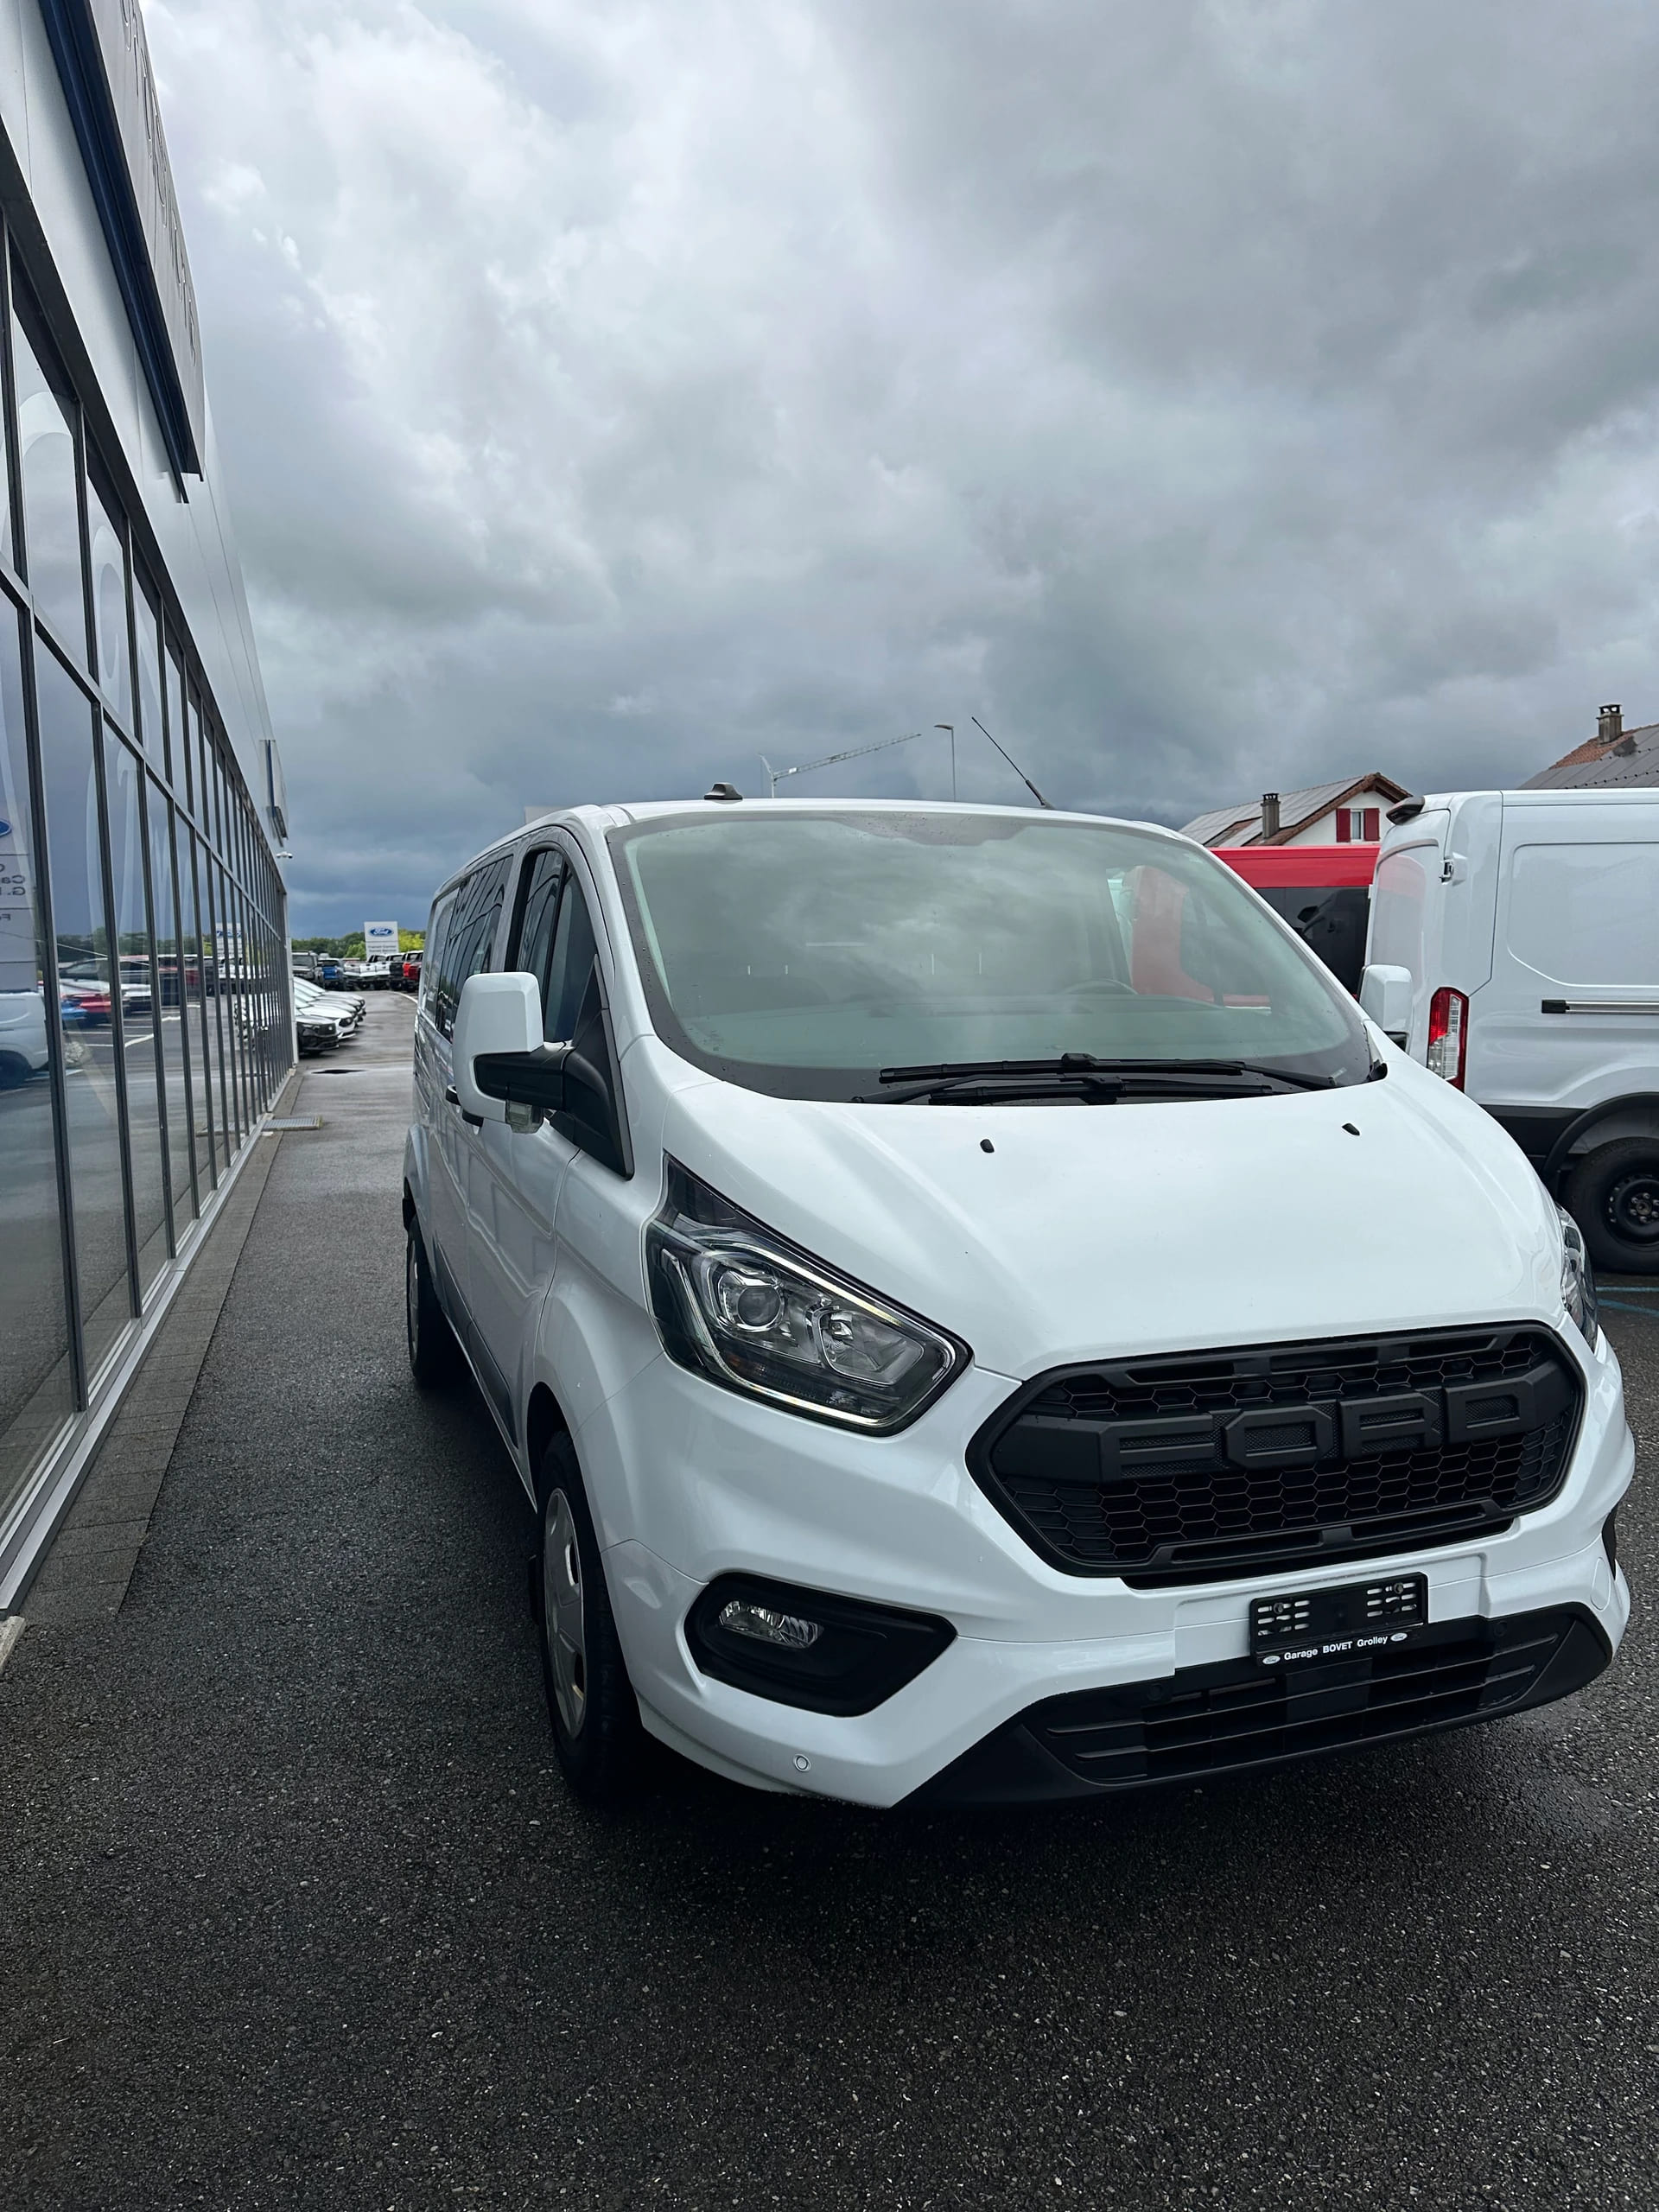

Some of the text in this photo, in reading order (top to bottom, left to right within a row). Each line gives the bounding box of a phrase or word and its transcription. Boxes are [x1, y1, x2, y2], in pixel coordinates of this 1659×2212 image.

[1098, 1376, 1535, 1484] FORD
[1284, 1649, 1318, 1661] Garage
[1322, 1641, 1353, 1654] BOVET
[1357, 1636, 1389, 1648] Grolley
